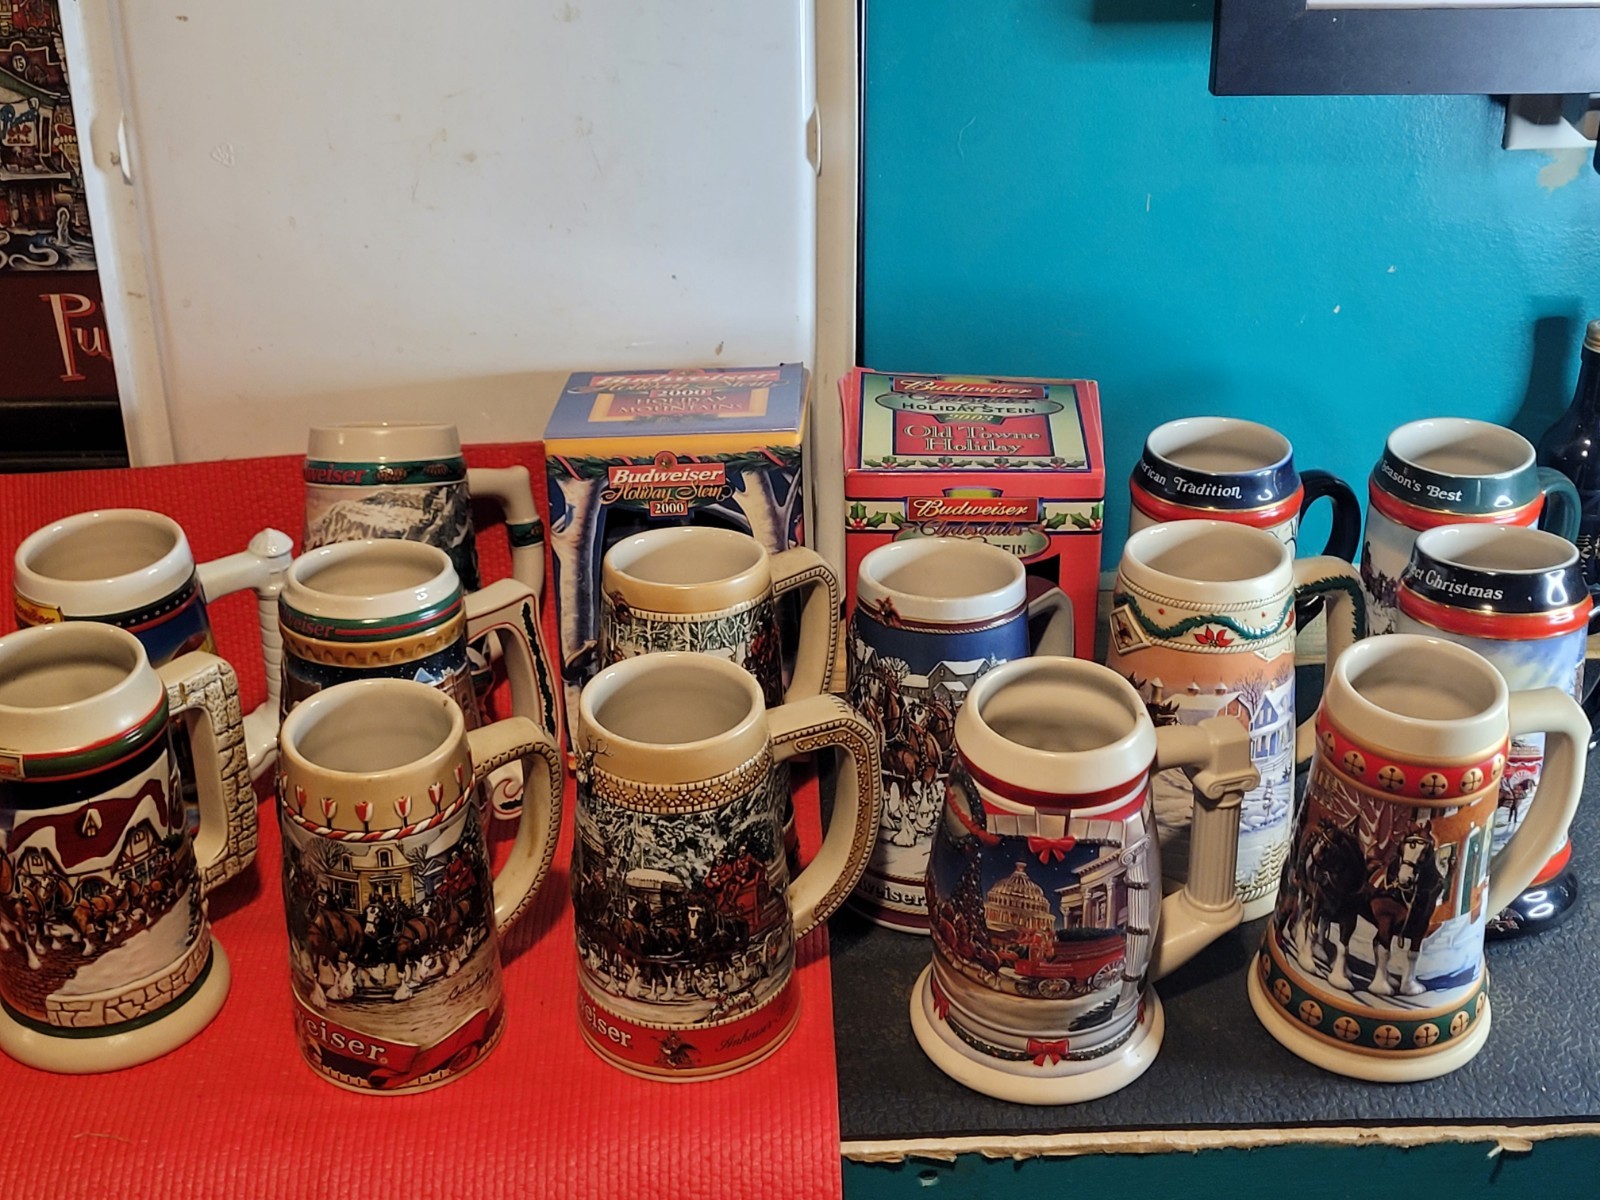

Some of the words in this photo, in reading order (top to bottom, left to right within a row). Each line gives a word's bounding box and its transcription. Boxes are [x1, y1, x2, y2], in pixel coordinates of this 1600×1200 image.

[38, 293, 112, 381] Pu
[657, 389, 706, 397] 2000
[900, 379, 1033, 394] Budweiser
[902, 403, 978, 412] HOLIDAY
[981, 406, 1036, 414] STEIN
[903, 424, 952, 439] Old
[957, 425, 1042, 440] Towne
[924, 438, 1023, 454] Holiday
[304, 463, 366, 483] weiser
[613, 467, 724, 485] Budweiser
[1141, 460, 1167, 485] erican
[1173, 476, 1243, 499] Tradition
[1381, 460, 1422, 492] Season's
[1426, 484, 1463, 501] Best
[601, 482, 673, 505] Holiday
[676, 480, 733, 501] Stein
[654, 503, 685, 514] 2000
[913, 499, 1029, 517] Budweiser
[919, 519, 1025, 538] Clydesdales
[1425, 569, 1504, 600] Christmas
